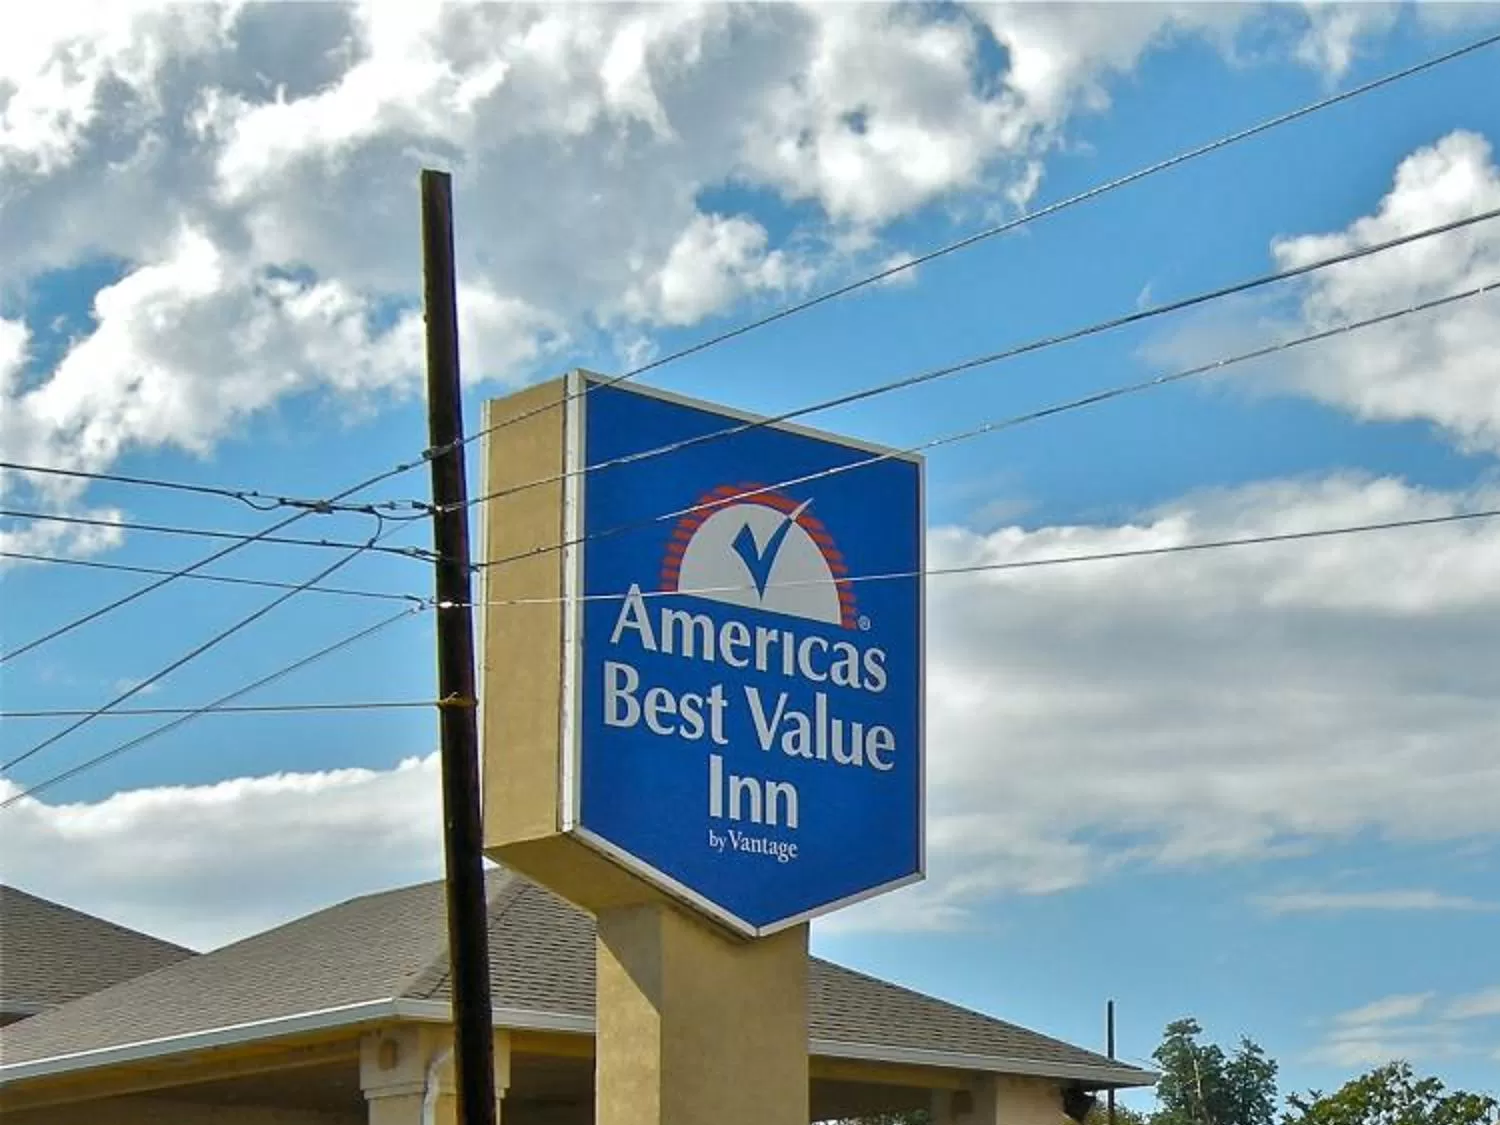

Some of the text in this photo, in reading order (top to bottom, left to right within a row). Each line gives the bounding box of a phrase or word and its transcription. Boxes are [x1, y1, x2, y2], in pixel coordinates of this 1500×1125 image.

[609, 583, 888, 693] Americas
[604, 660, 896, 771] Best Value
[709, 754, 799, 829] Inn
[709, 829, 798, 863] by Vantage
